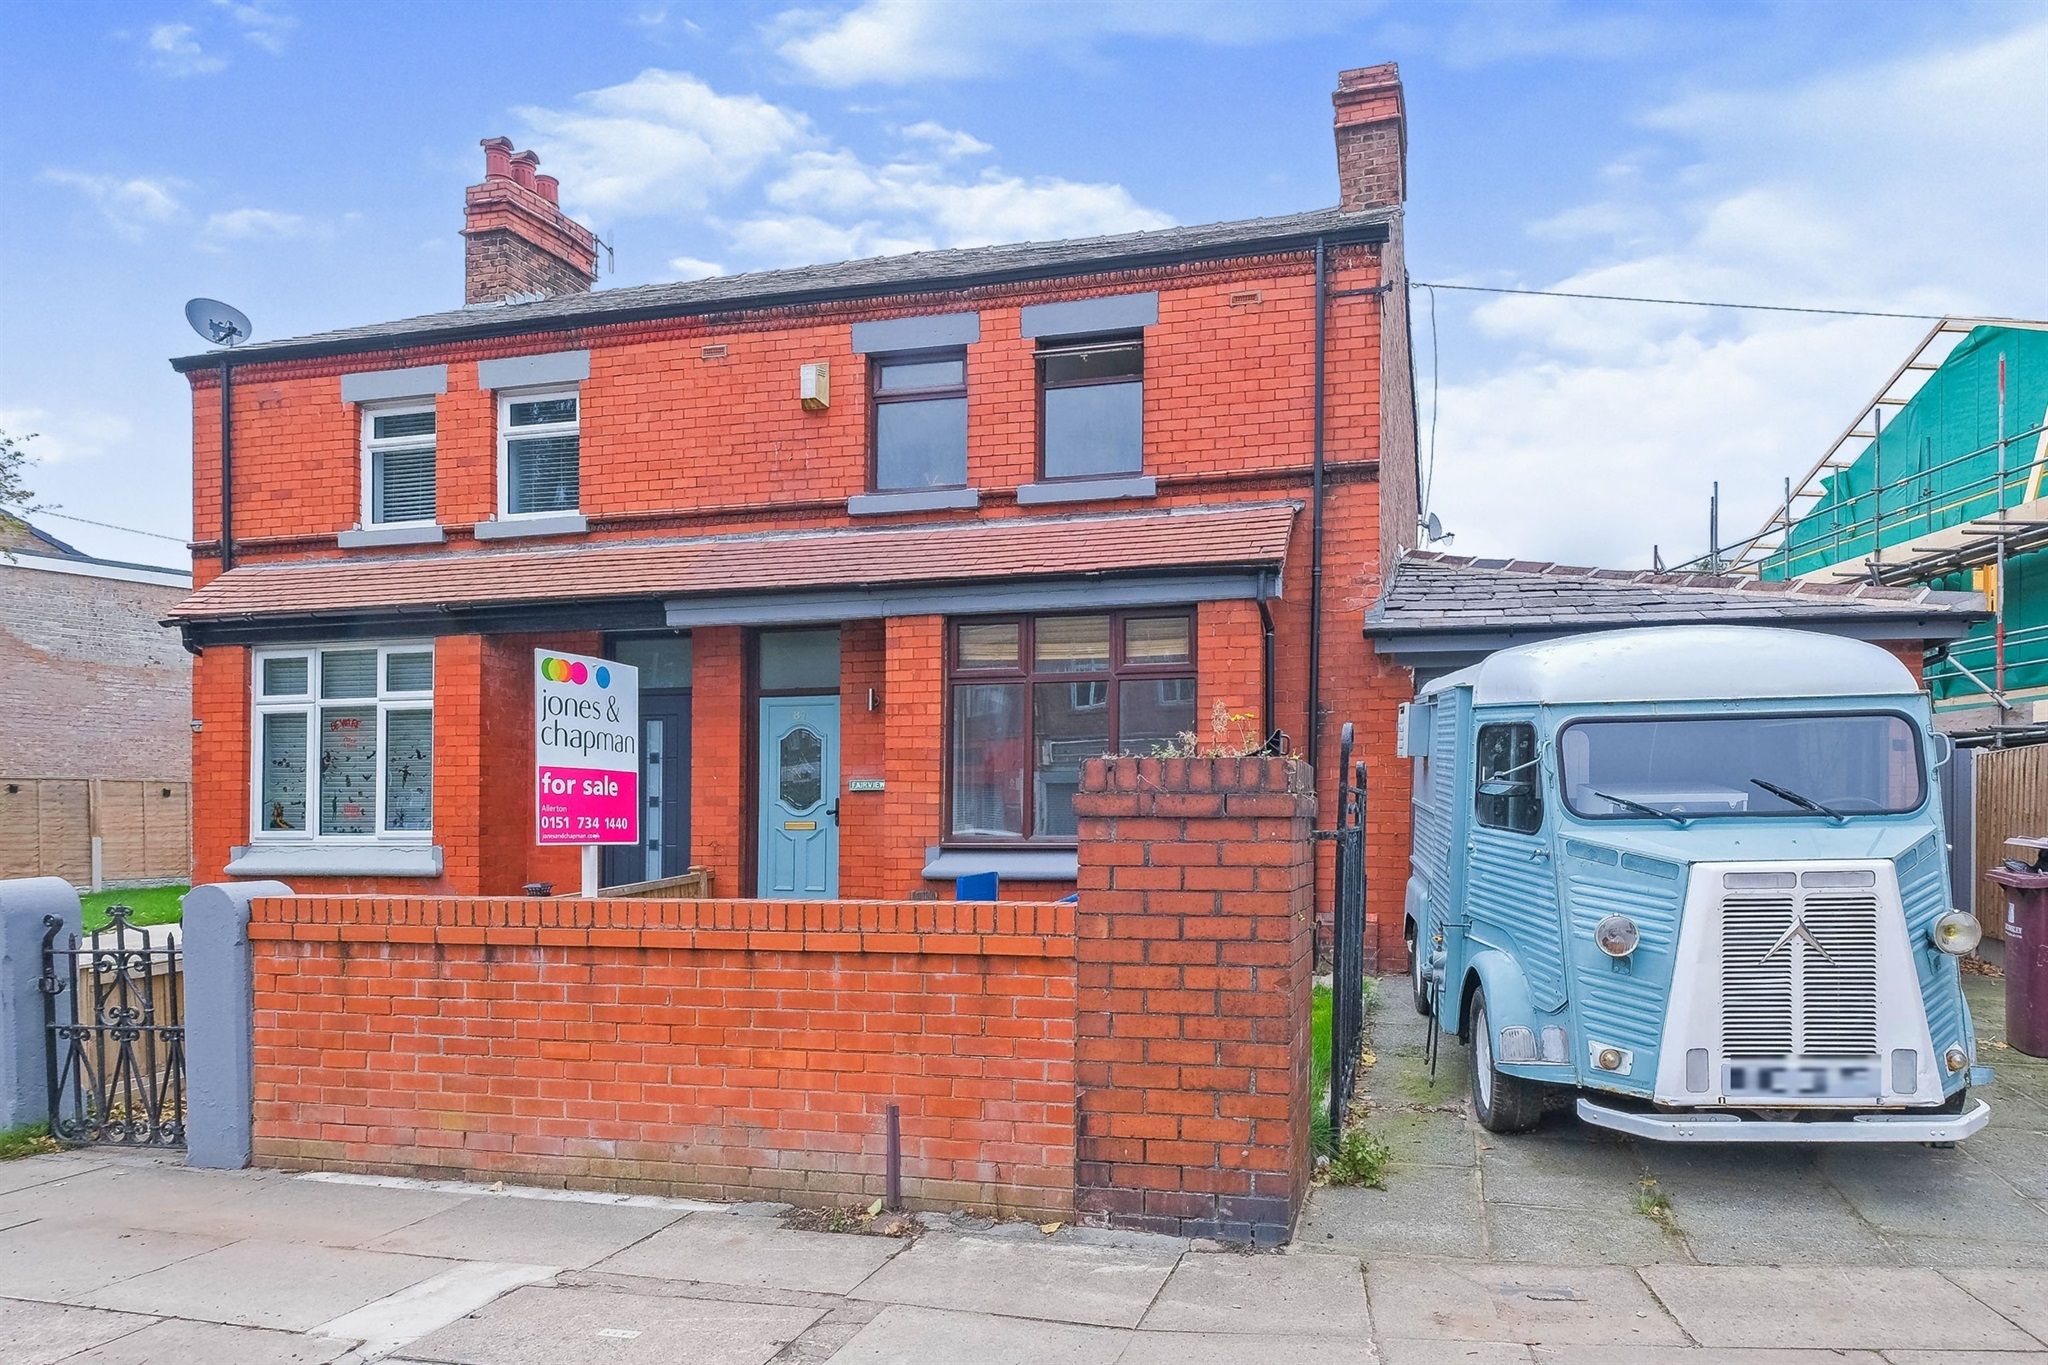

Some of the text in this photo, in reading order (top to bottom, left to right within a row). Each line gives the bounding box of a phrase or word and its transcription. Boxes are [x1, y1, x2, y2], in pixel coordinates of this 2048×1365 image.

[542, 689, 620, 722] jones &
[541, 719, 635, 757] chapman
[541, 772, 619, 797] for sale
[541, 804, 568, 812] Allerton
[541, 816, 628, 830] 0151 734 1440
